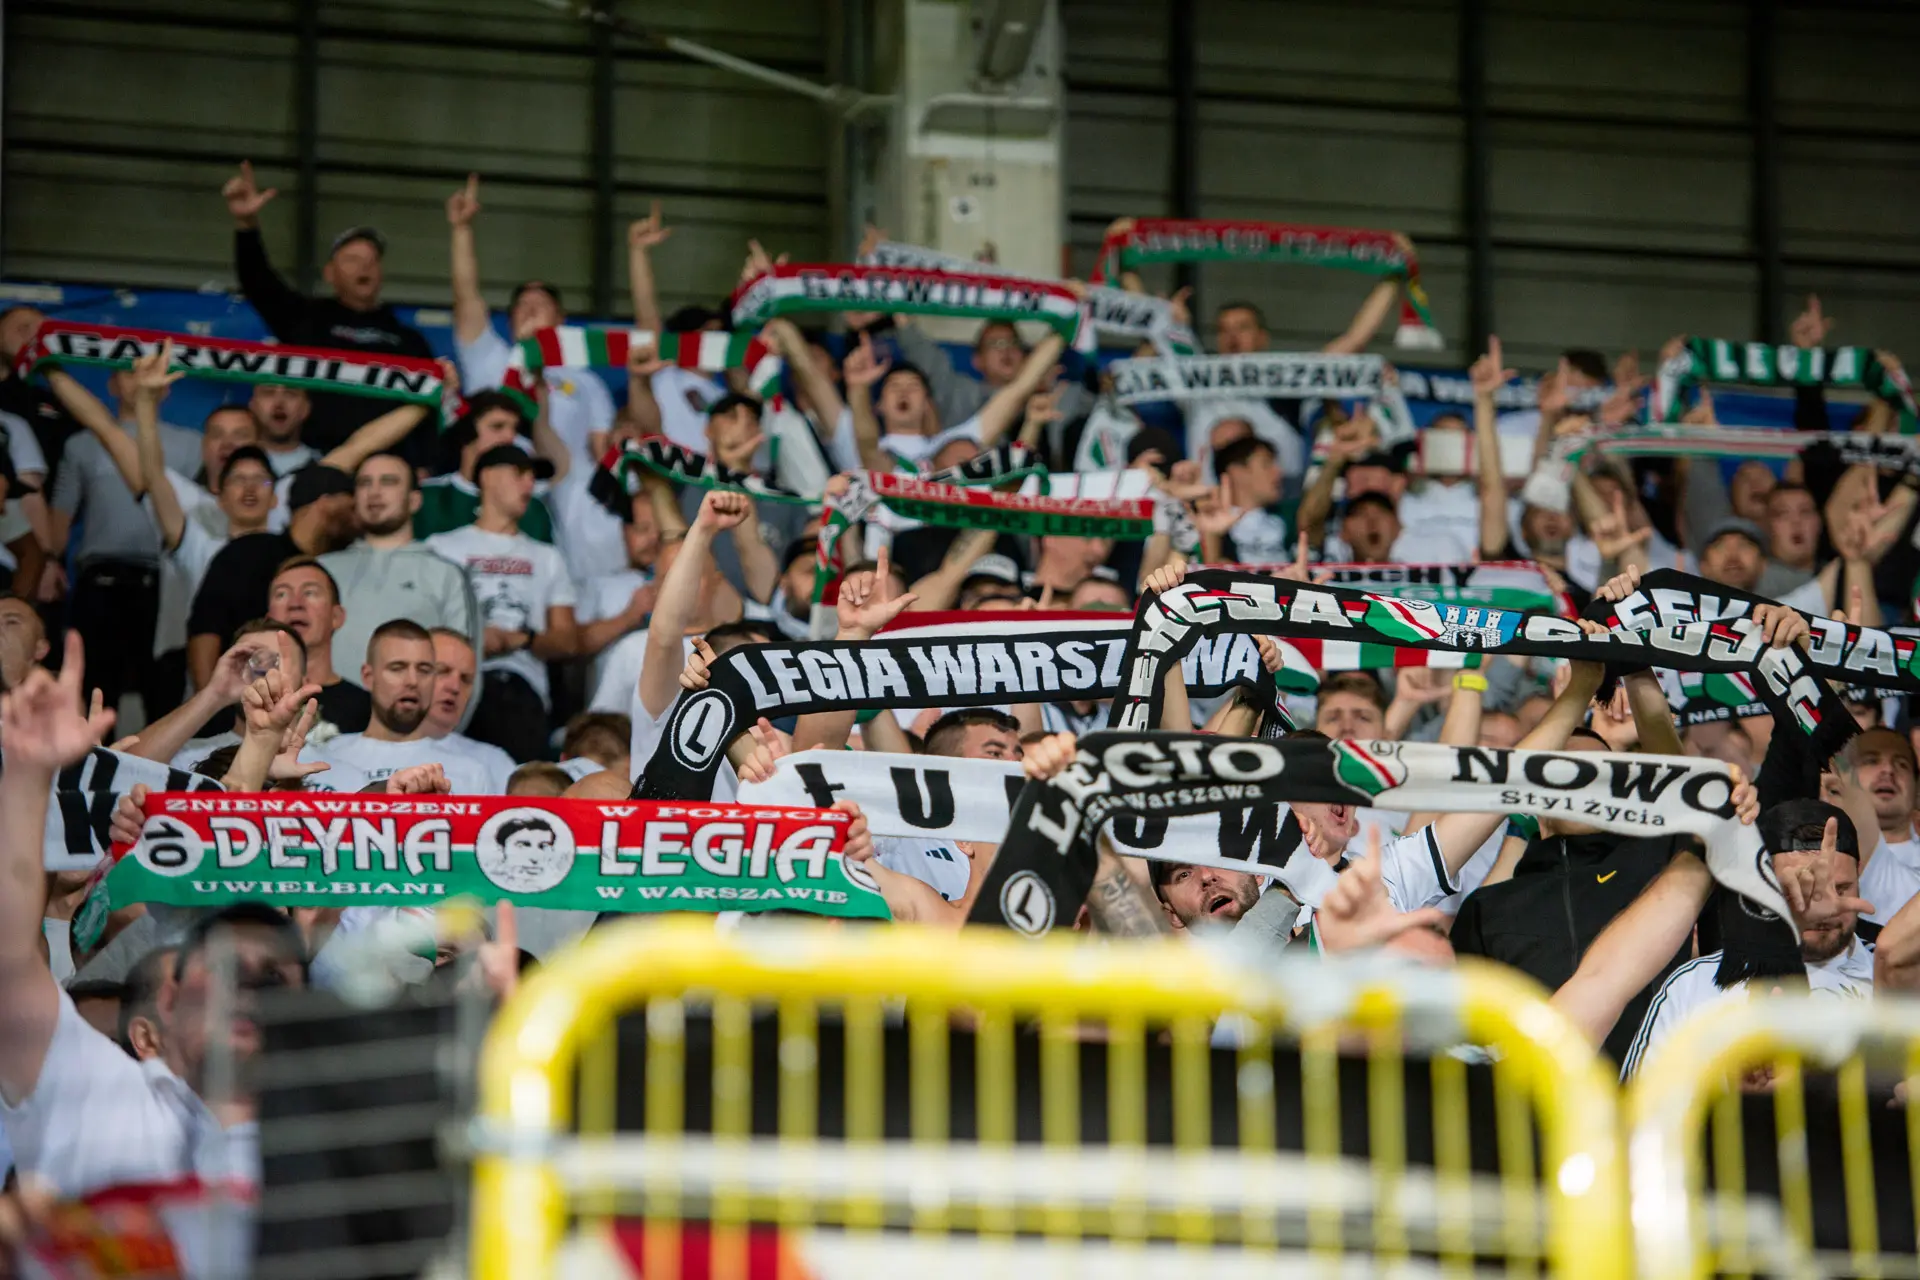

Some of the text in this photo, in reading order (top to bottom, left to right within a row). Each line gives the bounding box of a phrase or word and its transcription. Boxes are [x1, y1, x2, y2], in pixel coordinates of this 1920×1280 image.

[801, 268, 1046, 312] GARWOLIN
[57, 330, 430, 394] GARWOLIN
[1715, 338, 1857, 381] LEGIA
[874, 470, 970, 502] LEGIA
[1612, 588, 1899, 678] SEJA
[729, 632, 1261, 710] LEGIA WARSZWA
[1028, 740, 1285, 857] LEGIO
[1123, 784, 1264, 810] Warszawa
[1450, 746, 1736, 820] NOWO
[165, 799, 482, 815] ZNIENAWIDZENI
[596, 805, 850, 823] W POLSCE
[1501, 789, 1667, 828] Styl Życia
[209, 815, 452, 877] DEYNA
[599, 819, 837, 885] LEGIA
[190, 879, 446, 895] UWIELBIANI
[595, 885, 849, 904] W WARSZAWIE
